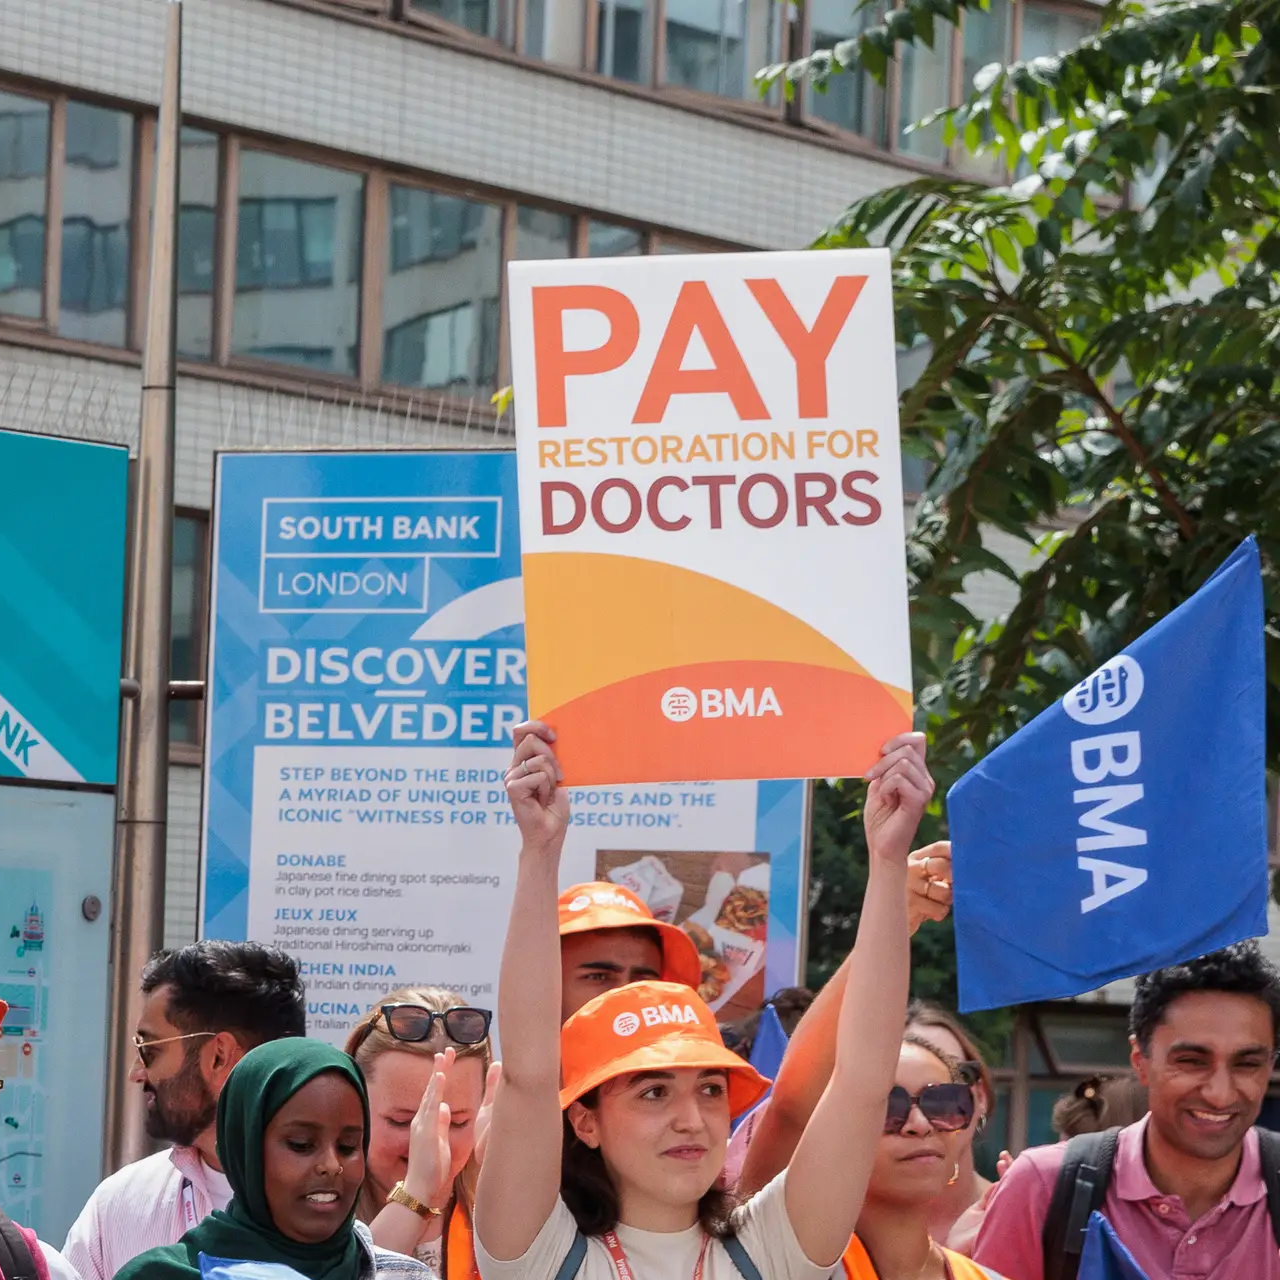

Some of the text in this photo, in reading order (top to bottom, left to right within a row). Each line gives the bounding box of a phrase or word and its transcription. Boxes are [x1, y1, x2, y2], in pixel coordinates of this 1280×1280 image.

[531, 275, 867, 428] PAY
[537, 428, 879, 469] RESTORATION FOR
[540, 471, 883, 536] DOCTORS
[278, 515, 480, 540] SOUTH BANK
[277, 571, 409, 598] LONDON
[268, 647, 525, 685] DISCOVER
[701, 686, 782, 719] BMA
[264, 703, 525, 742] BELVEDER
[280, 767, 448, 782] STEP BEYOND THE
[279, 789, 480, 805] A MYRIAD OF UNIQUE
[630, 792, 716, 807] AND THE
[279, 809, 342, 822] ICONIC
[450, 811, 486, 824] FOR
[1070, 733, 1148, 914] BMA
[277, 854, 346, 867] DONABE
[275, 870, 500, 887] Japanese fine dining spot specialising
[275, 886, 285, 896] in
[289, 886, 312, 898] clay
[315, 887, 334, 898] pot
[338, 887, 359, 897] rice
[274, 908, 357, 922] JEUX JEUX
[274, 924, 434, 940] Japanese dining serving up
[274, 940, 394, 951] traditional Hiroshima
[349, 964, 396, 976] INDIA
[315, 980, 349, 990] Indian
[353, 980, 388, 993] dining
[642, 1005, 699, 1027] BMA
[315, 1020, 350, 1029] Italian
[616, 1259, 628, 1276] BMA
